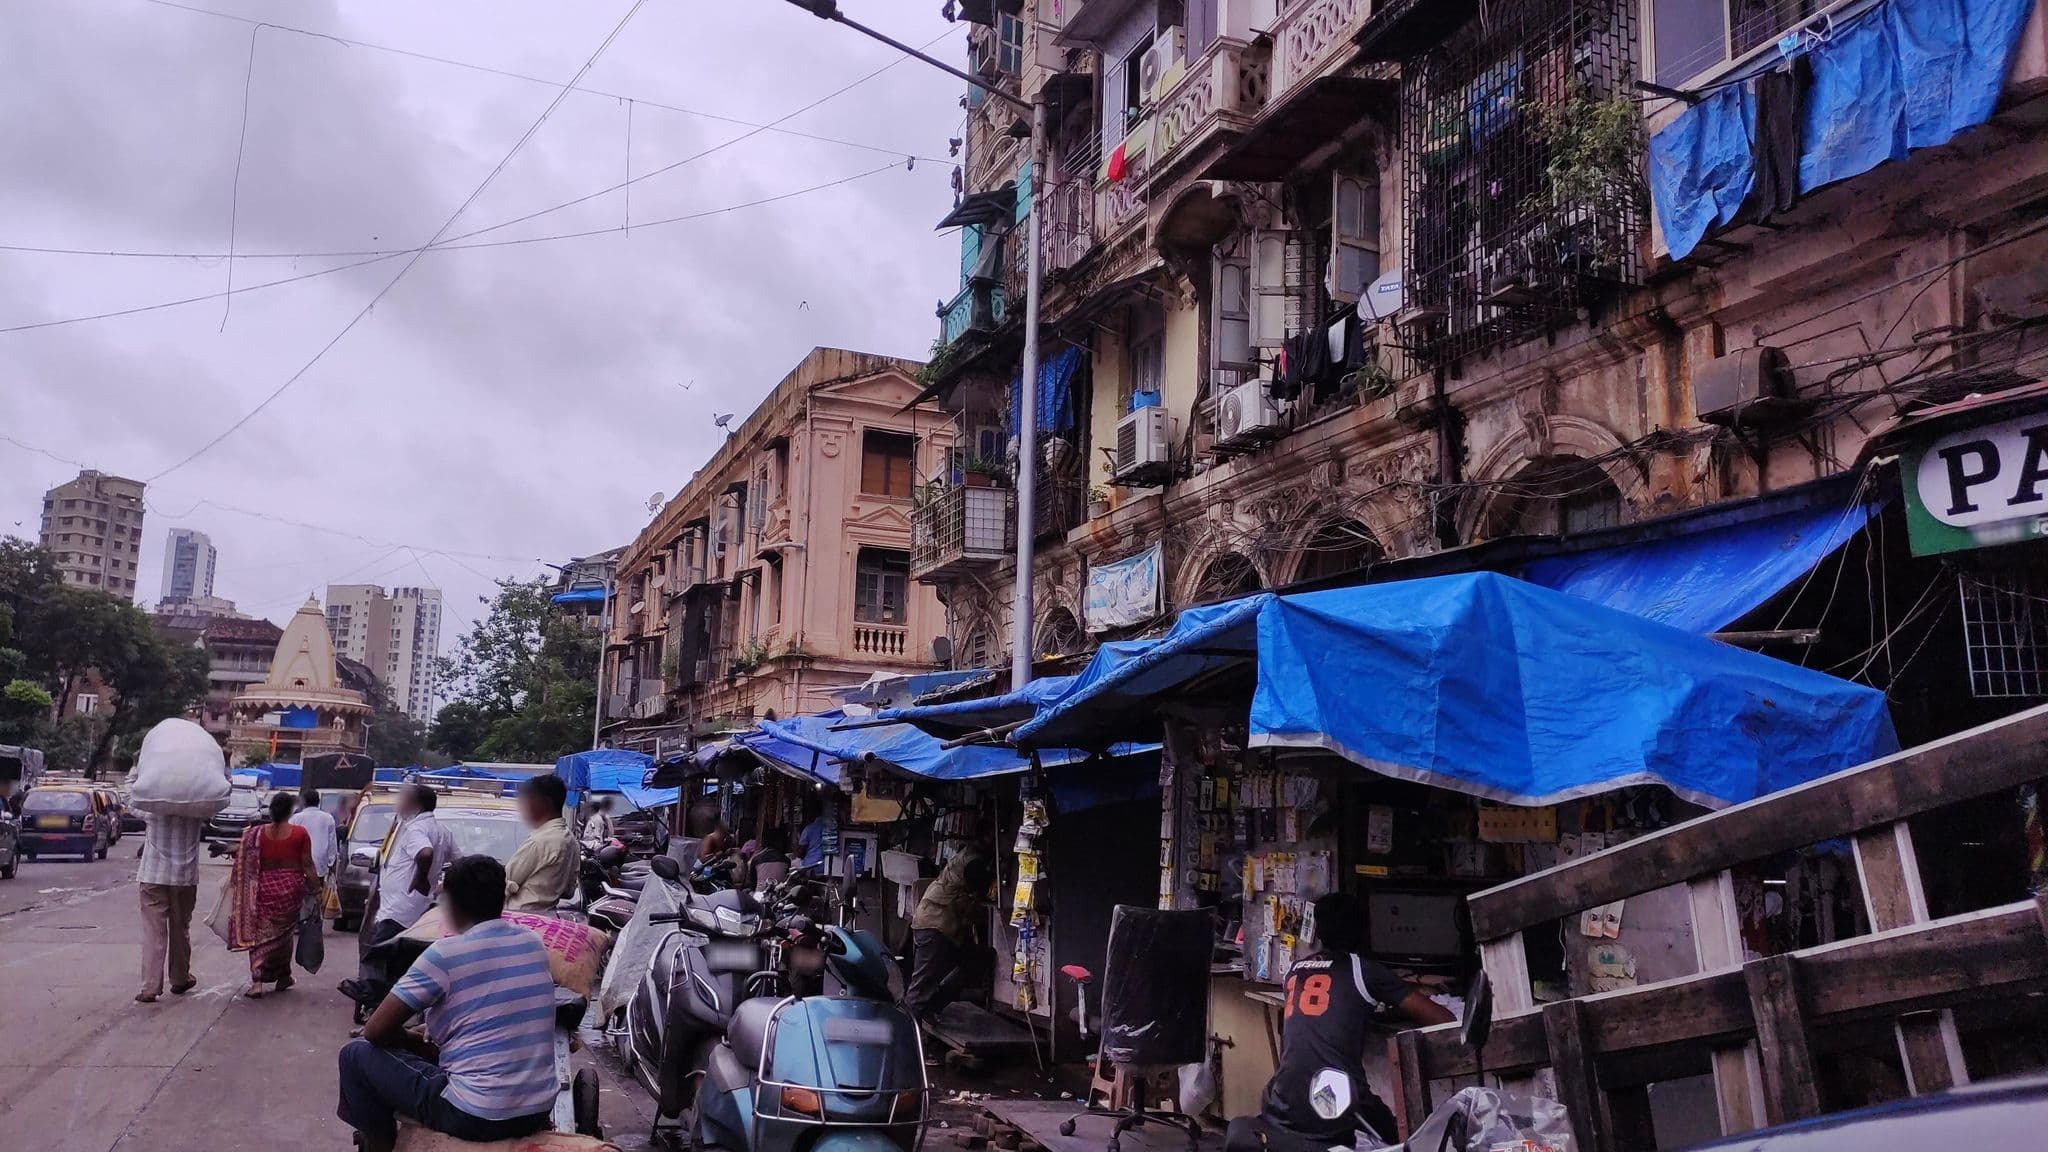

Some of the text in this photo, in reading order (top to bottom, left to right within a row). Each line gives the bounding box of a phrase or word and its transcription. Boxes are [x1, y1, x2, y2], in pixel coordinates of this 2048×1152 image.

[1380, 284, 1399, 292] TATA
[1938, 424, 2048, 516] PA
[1284, 974, 1332, 1018] 18
